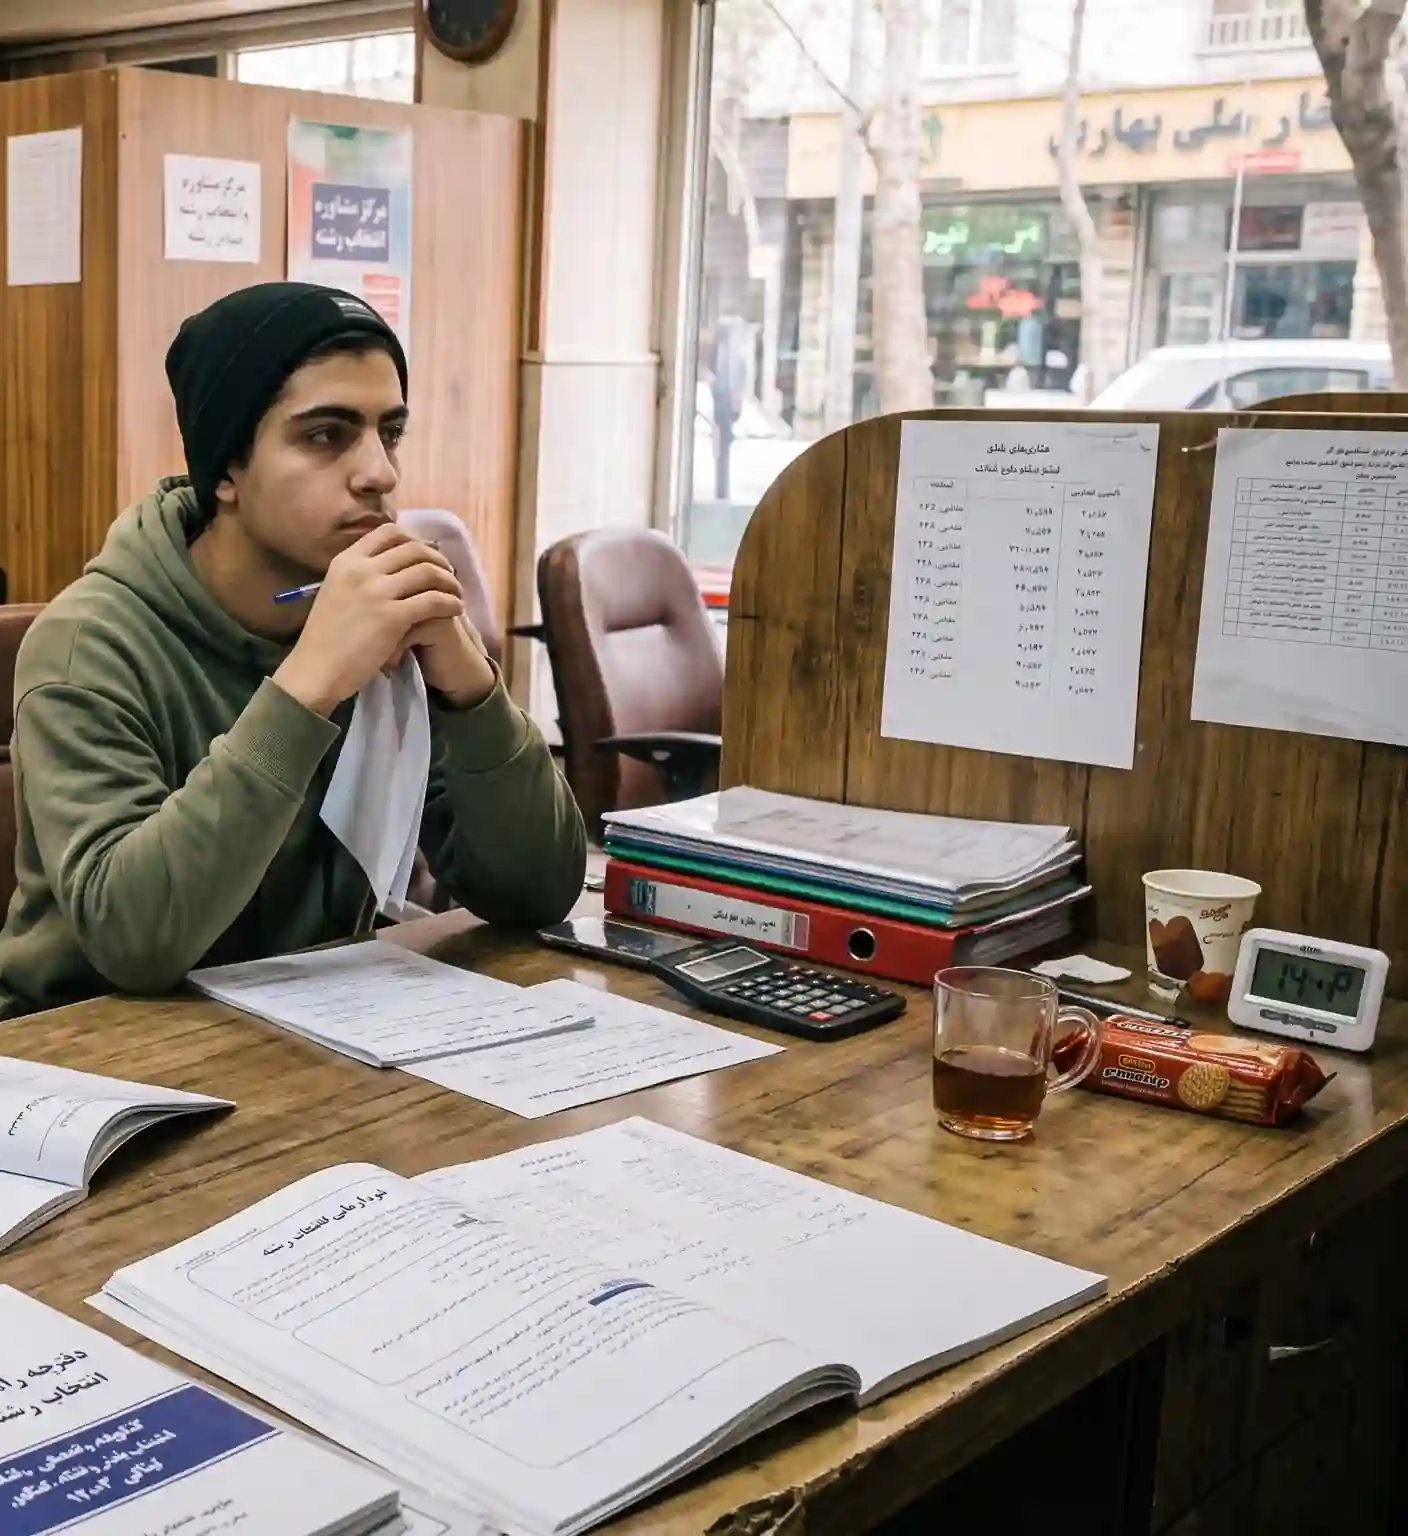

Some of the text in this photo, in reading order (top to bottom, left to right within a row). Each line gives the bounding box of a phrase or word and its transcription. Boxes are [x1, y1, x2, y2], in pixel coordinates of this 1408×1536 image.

[314, 193, 389, 225] مرکز مشاوره
[314, 227, 387, 253] انتخاب رشته
[27, 1348, 88, 1378] دفترچه
[40, 1371, 110, 1406] انتخاب
